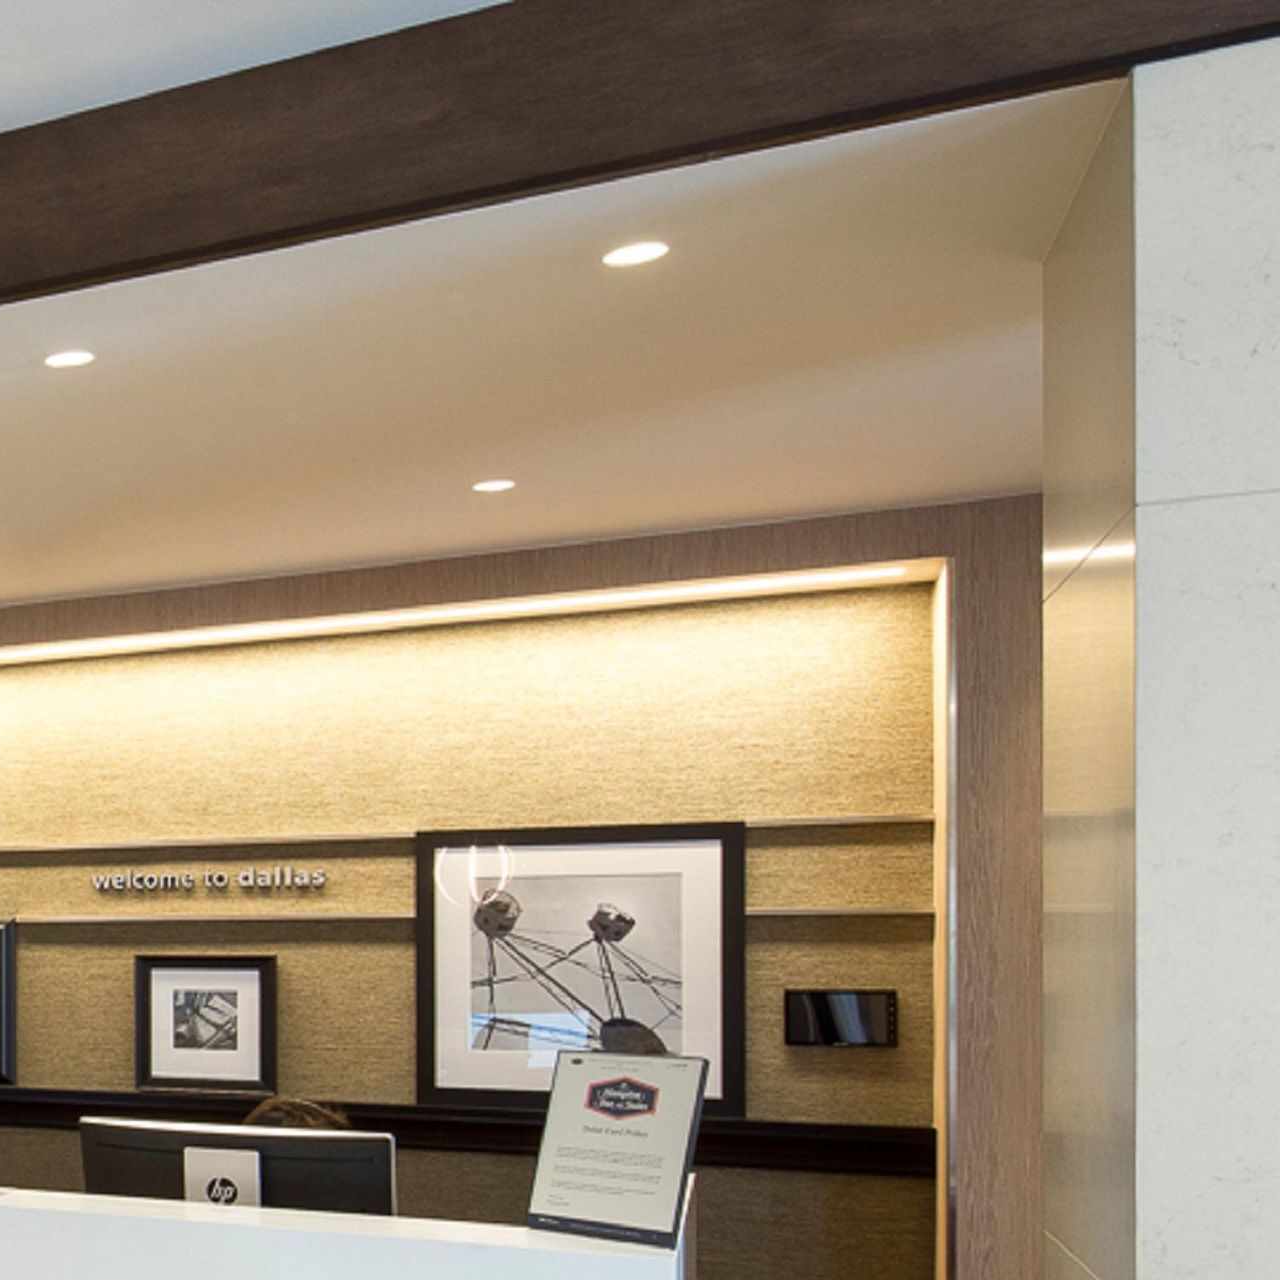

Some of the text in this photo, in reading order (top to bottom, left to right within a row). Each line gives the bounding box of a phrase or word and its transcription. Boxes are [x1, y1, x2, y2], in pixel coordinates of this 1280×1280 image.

[91, 865, 327, 891] welcome to dallas
[207, 1177, 238, 1205] hp
